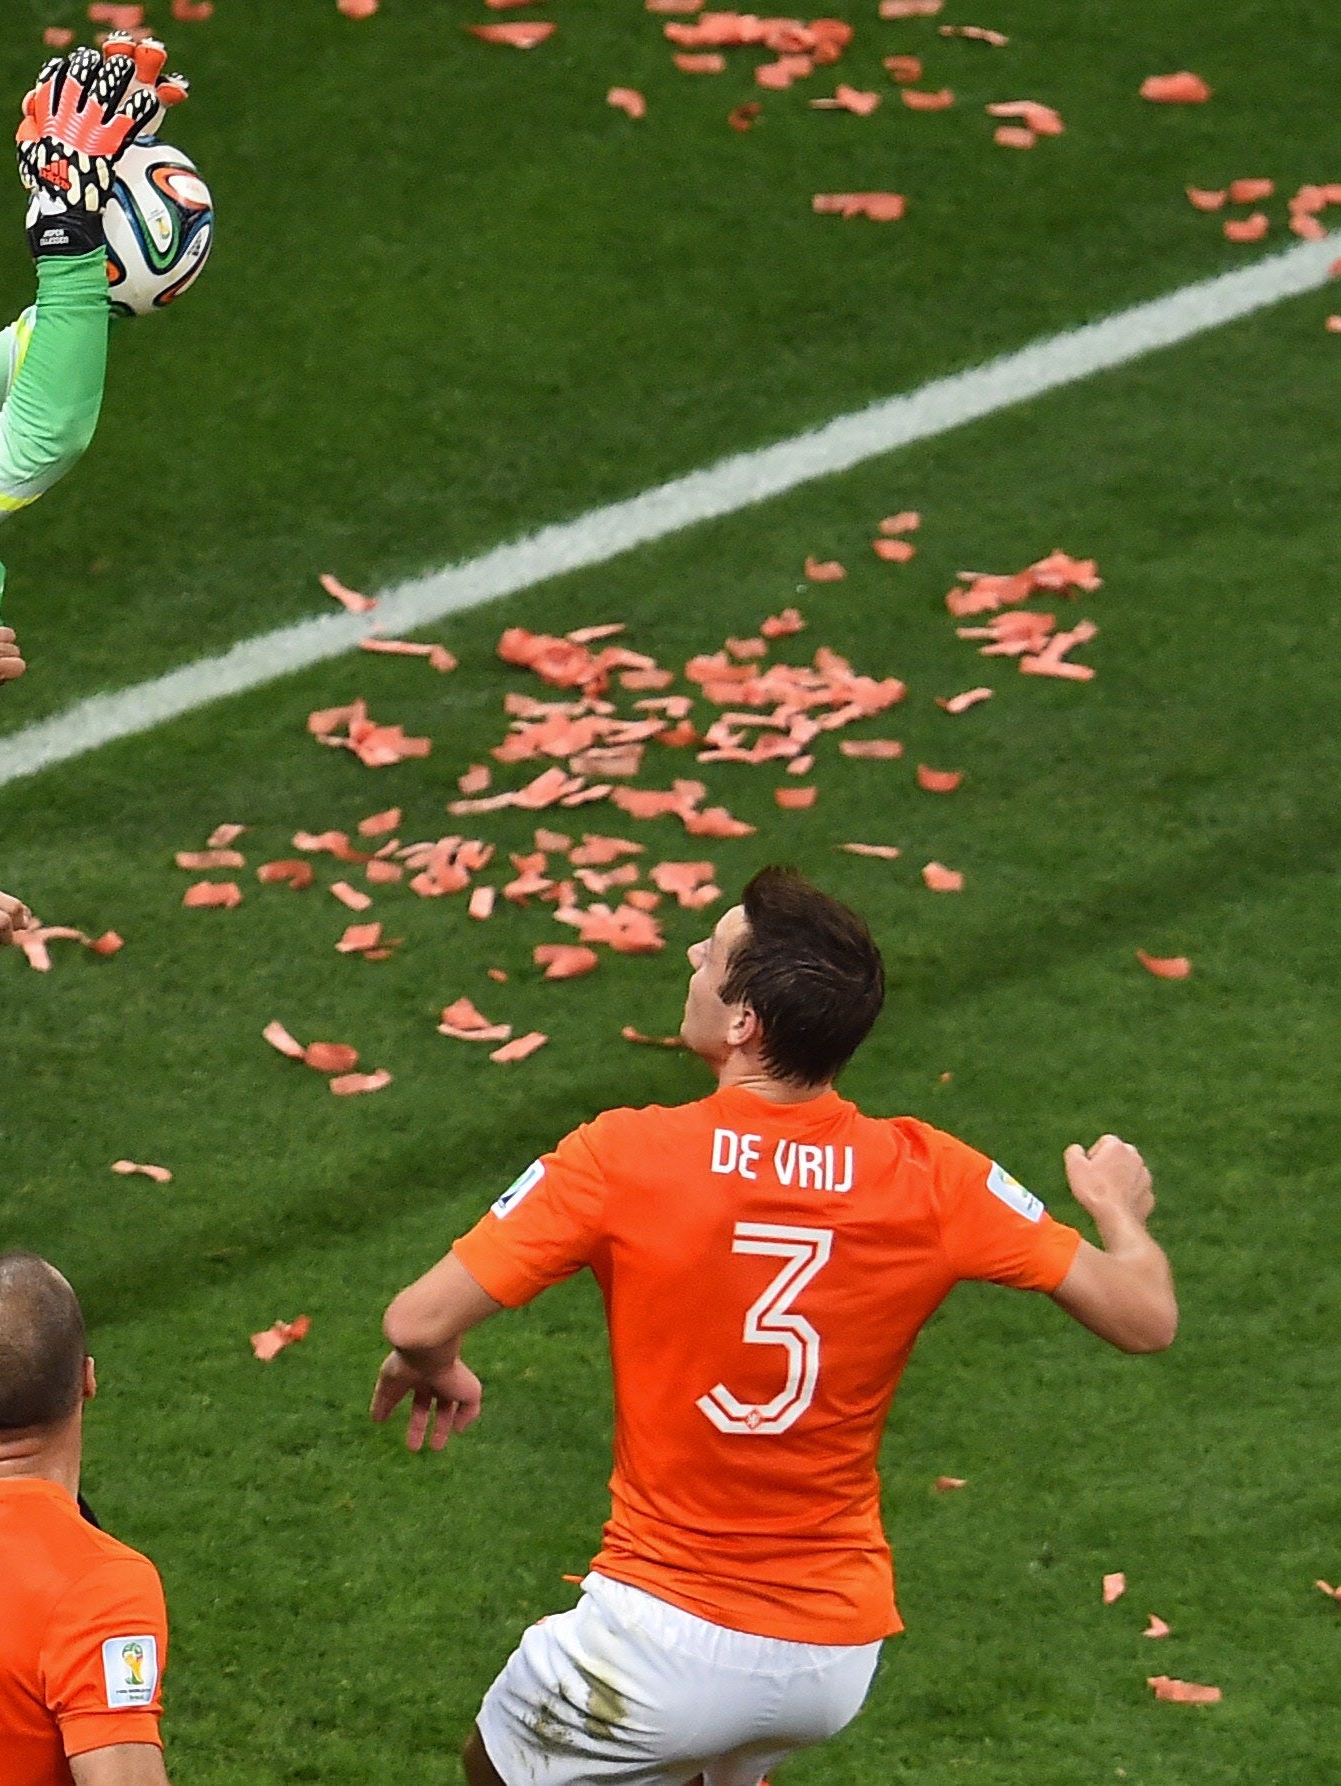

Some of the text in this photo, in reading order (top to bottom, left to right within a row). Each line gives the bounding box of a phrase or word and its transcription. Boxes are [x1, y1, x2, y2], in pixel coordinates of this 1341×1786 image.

[711, 1128, 854, 1192] DE VRIJ
[696, 1221, 835, 1435] 3
